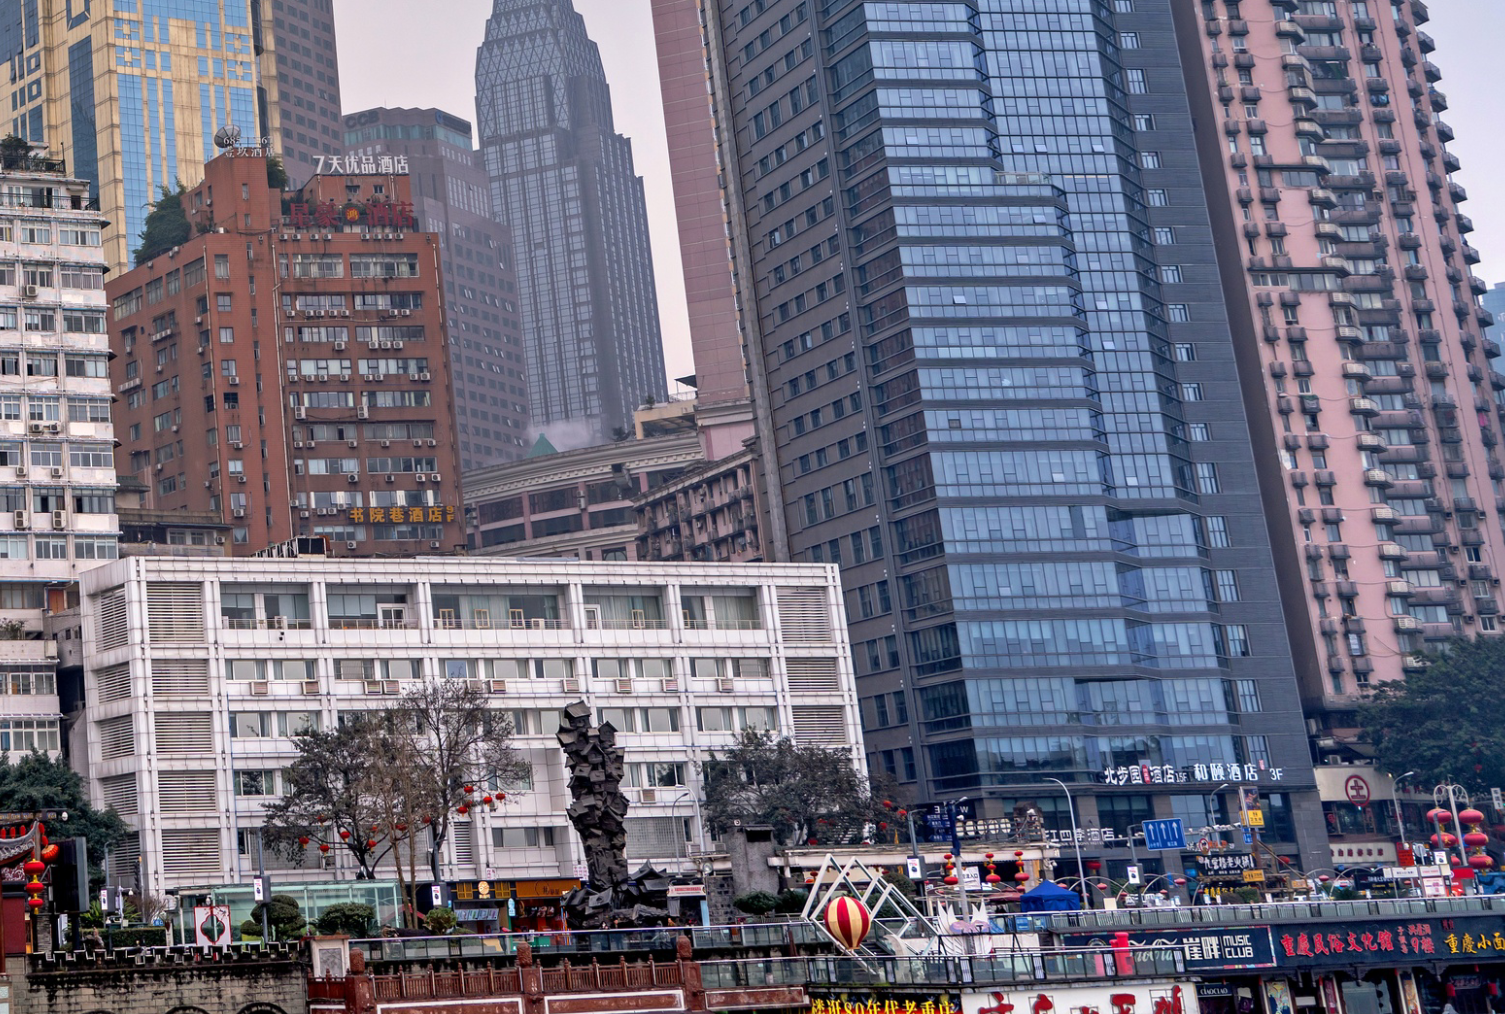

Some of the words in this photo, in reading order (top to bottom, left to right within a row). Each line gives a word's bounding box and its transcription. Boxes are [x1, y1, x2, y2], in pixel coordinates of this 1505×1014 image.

[345, 110, 380, 129] CCB
[312, 154, 409, 175] 7天优品酒店
[289, 201, 339, 229] 星豪
[366, 200, 415, 228] 酒店
[349, 507, 443, 523] 书院巷酒店
[1149, 764, 1175, 784] 酒店
[1194, 763, 1259, 781] 和颐酒店
[1270, 768, 1283, 781] 3F
[1223, 935, 1251, 947] MUSIC
[1225, 947, 1253, 958] CLUB
